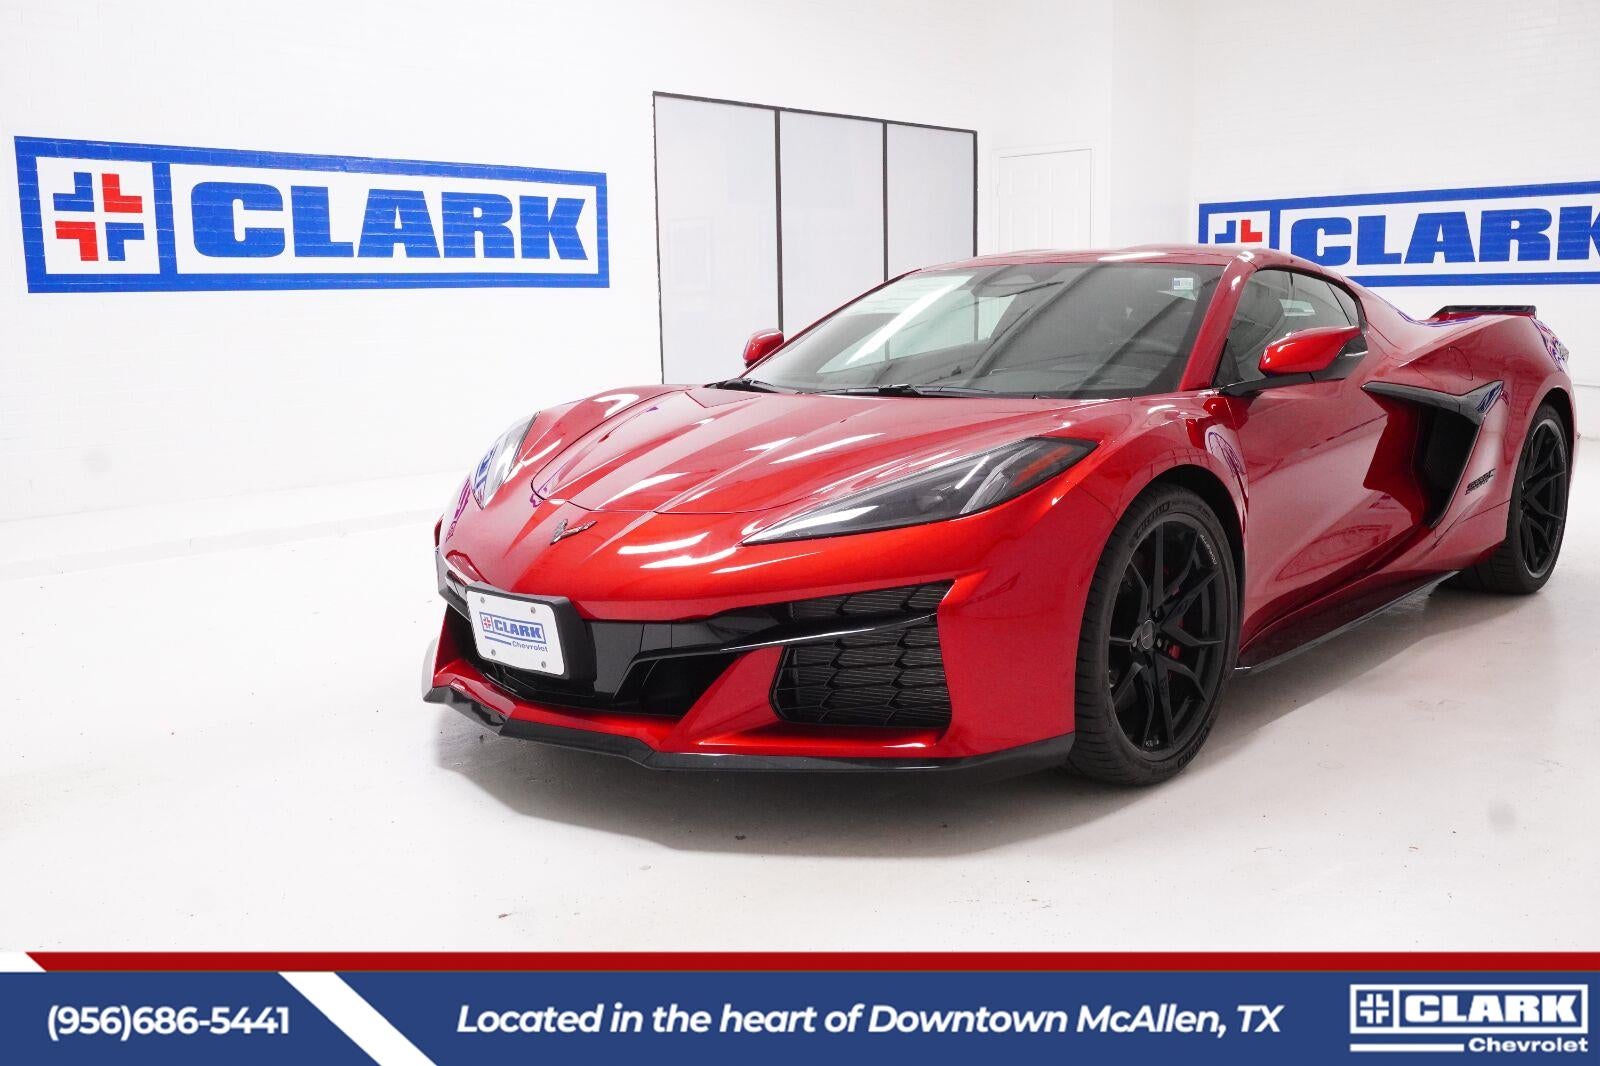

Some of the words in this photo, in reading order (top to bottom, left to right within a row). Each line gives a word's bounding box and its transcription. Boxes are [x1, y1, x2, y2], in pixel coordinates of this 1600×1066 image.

[190, 181, 588, 261] CLARK
[493, 619, 541, 639] CLARK
[512, 641, 548, 652] Chevrolet
